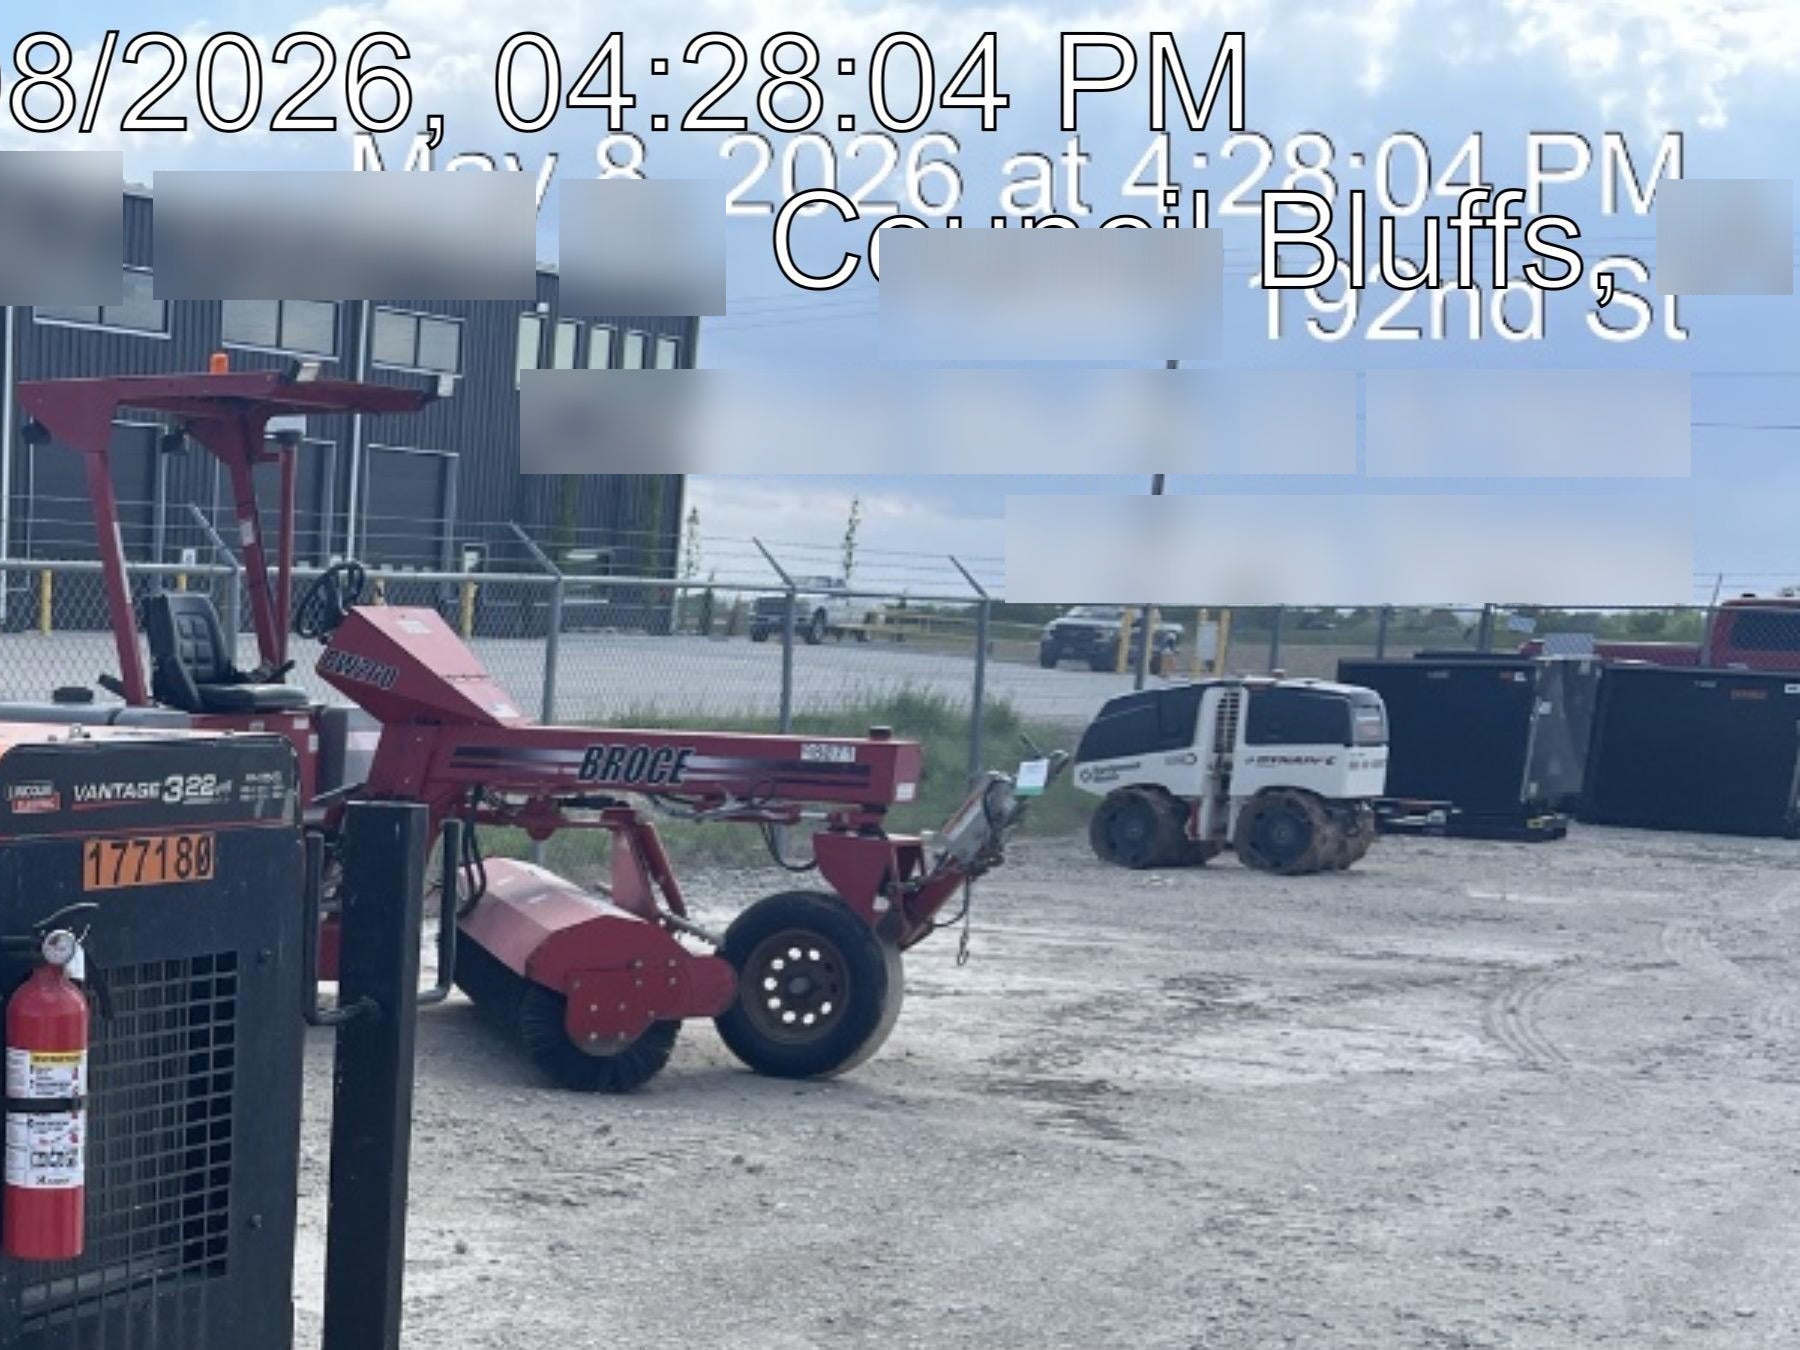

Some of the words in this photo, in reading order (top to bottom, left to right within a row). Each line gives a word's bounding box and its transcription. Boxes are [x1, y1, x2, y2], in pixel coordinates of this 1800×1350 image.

[577, 744, 697, 785] BROCE
[73, 782, 162, 802] VANTAGE
[87, 836, 213, 886] 177180
